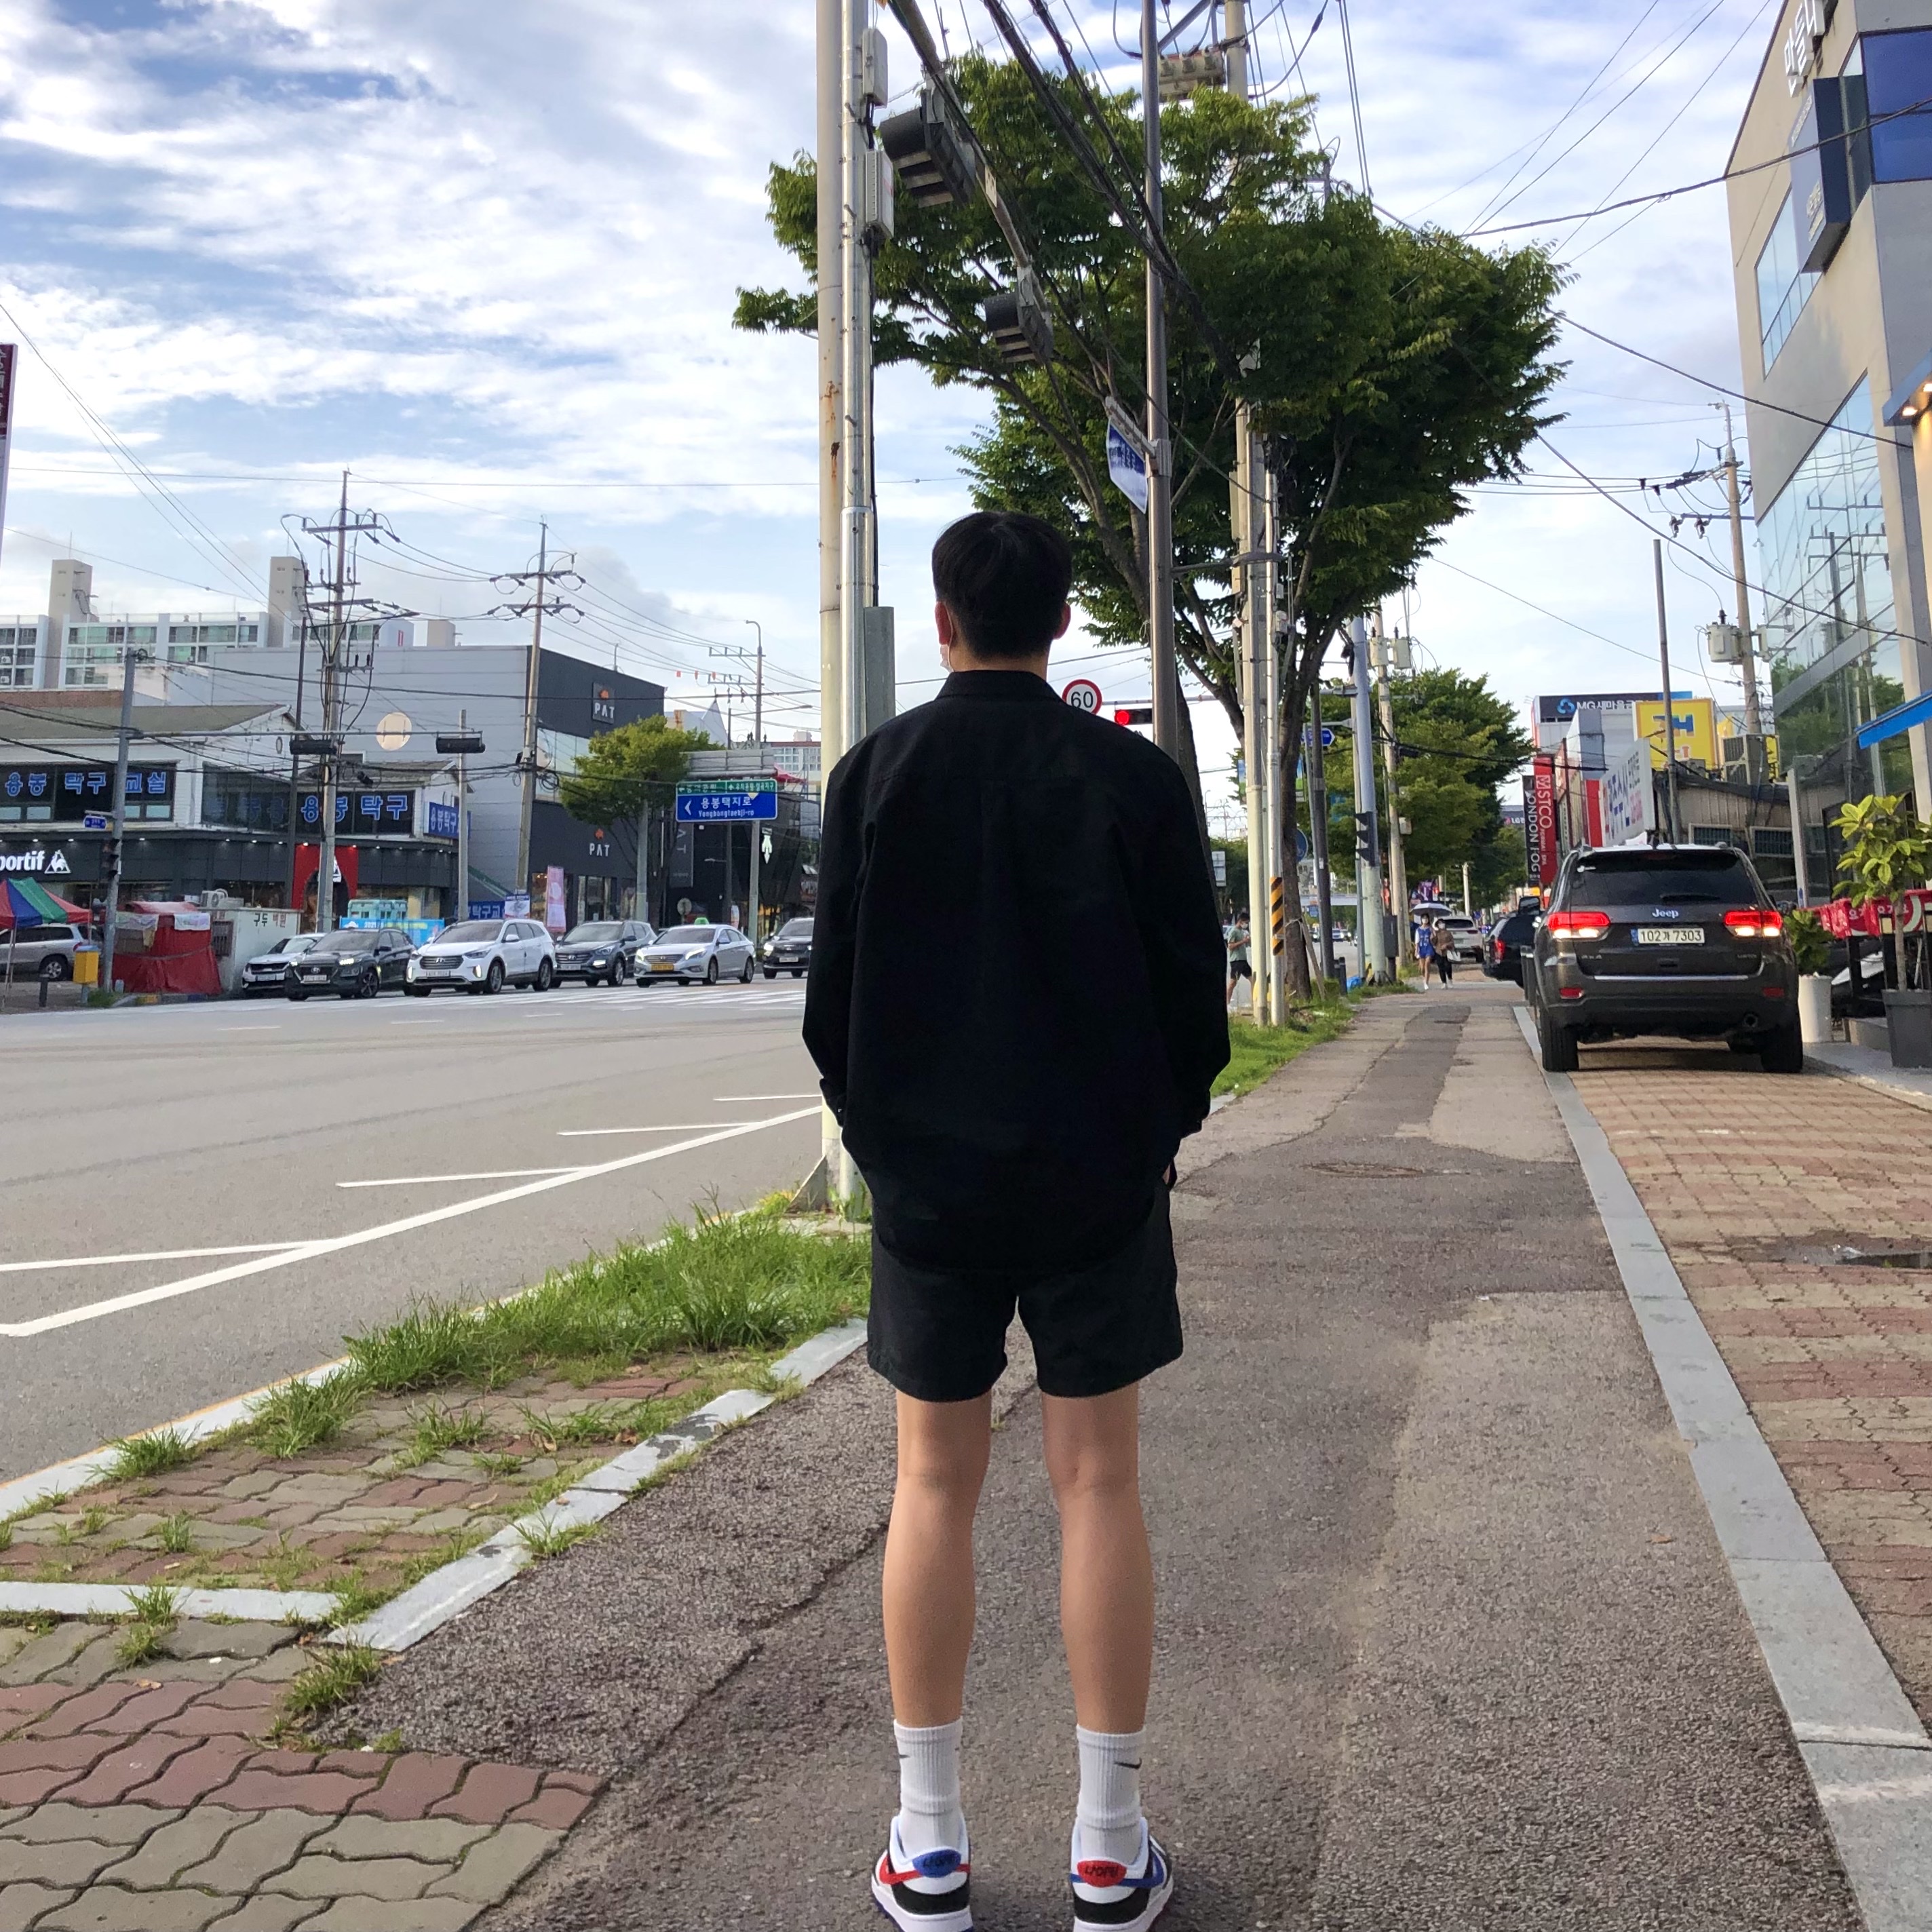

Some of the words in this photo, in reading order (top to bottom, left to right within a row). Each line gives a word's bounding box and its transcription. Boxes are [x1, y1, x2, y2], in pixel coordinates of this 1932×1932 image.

[1071, 691, 1094, 708] 60
[594, 702, 615, 719] PAT
[5, 771, 47, 796] 용봉
[64, 772, 107, 794] 탁구
[361, 794, 408, 821] 탁구
[701, 796, 752, 809] 용봉택지로
[1537, 790, 1552, 829] STCO
[431, 806, 460, 834] 용봉탁구
[589, 843, 610, 857] PAT
[253, 912, 269, 927] 구두
[1652, 908, 1680, 919] Jeep
[1674, 930, 1703, 942] 7303
